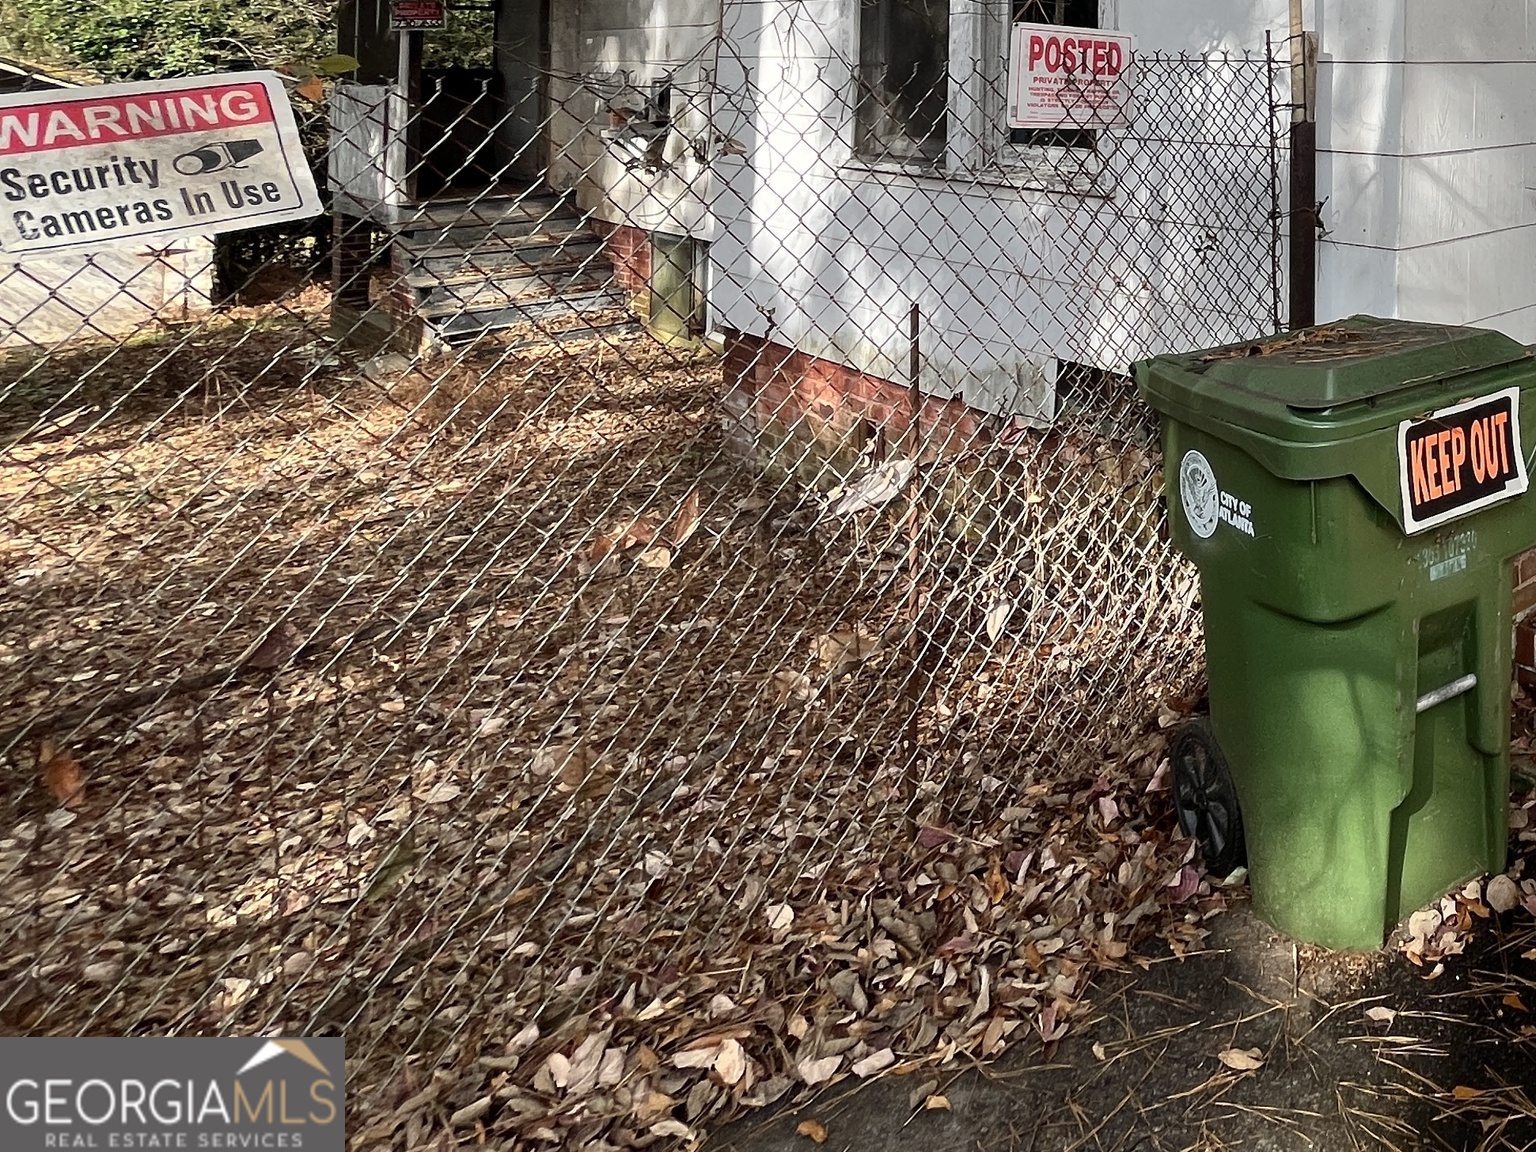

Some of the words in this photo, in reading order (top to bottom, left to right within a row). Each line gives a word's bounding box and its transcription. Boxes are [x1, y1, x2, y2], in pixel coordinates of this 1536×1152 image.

[1028, 35, 1122, 76] POSTED
[1073, 78, 1114, 87] PRORTY
[0, 89, 260, 150] WARNING
[2, 155, 158, 201] Security
[13, 199, 173, 240] Cameras
[180, 188, 215, 216] In
[221, 180, 281, 210] Use
[1410, 426, 1466, 506] KEEP
[1470, 411, 1509, 484] OUT
[1219, 505, 1255, 537] ATLANTA
[1220, 491, 1238, 511] CITY
[1239, 501, 1251, 518] OF
